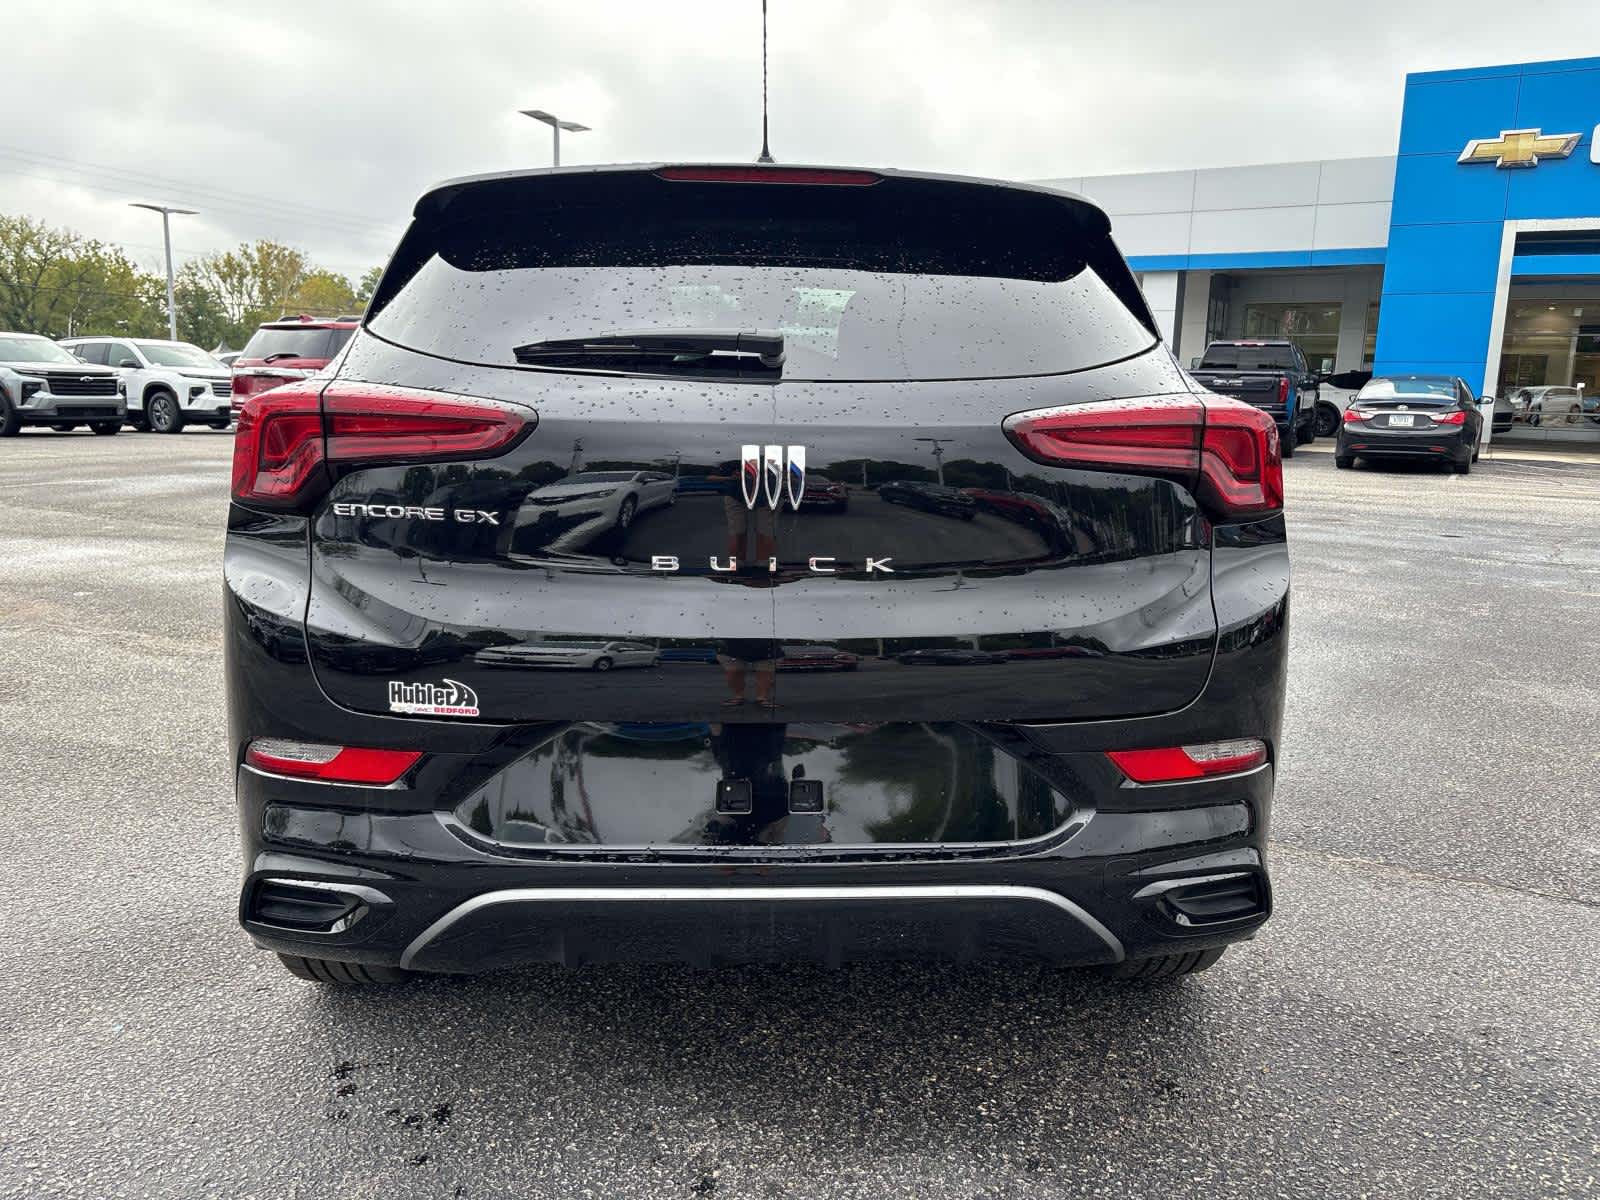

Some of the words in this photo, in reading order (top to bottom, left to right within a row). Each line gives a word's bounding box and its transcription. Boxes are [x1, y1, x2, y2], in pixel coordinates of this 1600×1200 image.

[333, 503, 445, 521] ENCORE
[454, 509, 499, 525] GX
[651, 555, 895, 573] BUICK
[389, 681, 456, 706] Hubler
[434, 707, 478, 715] BEDFORD
